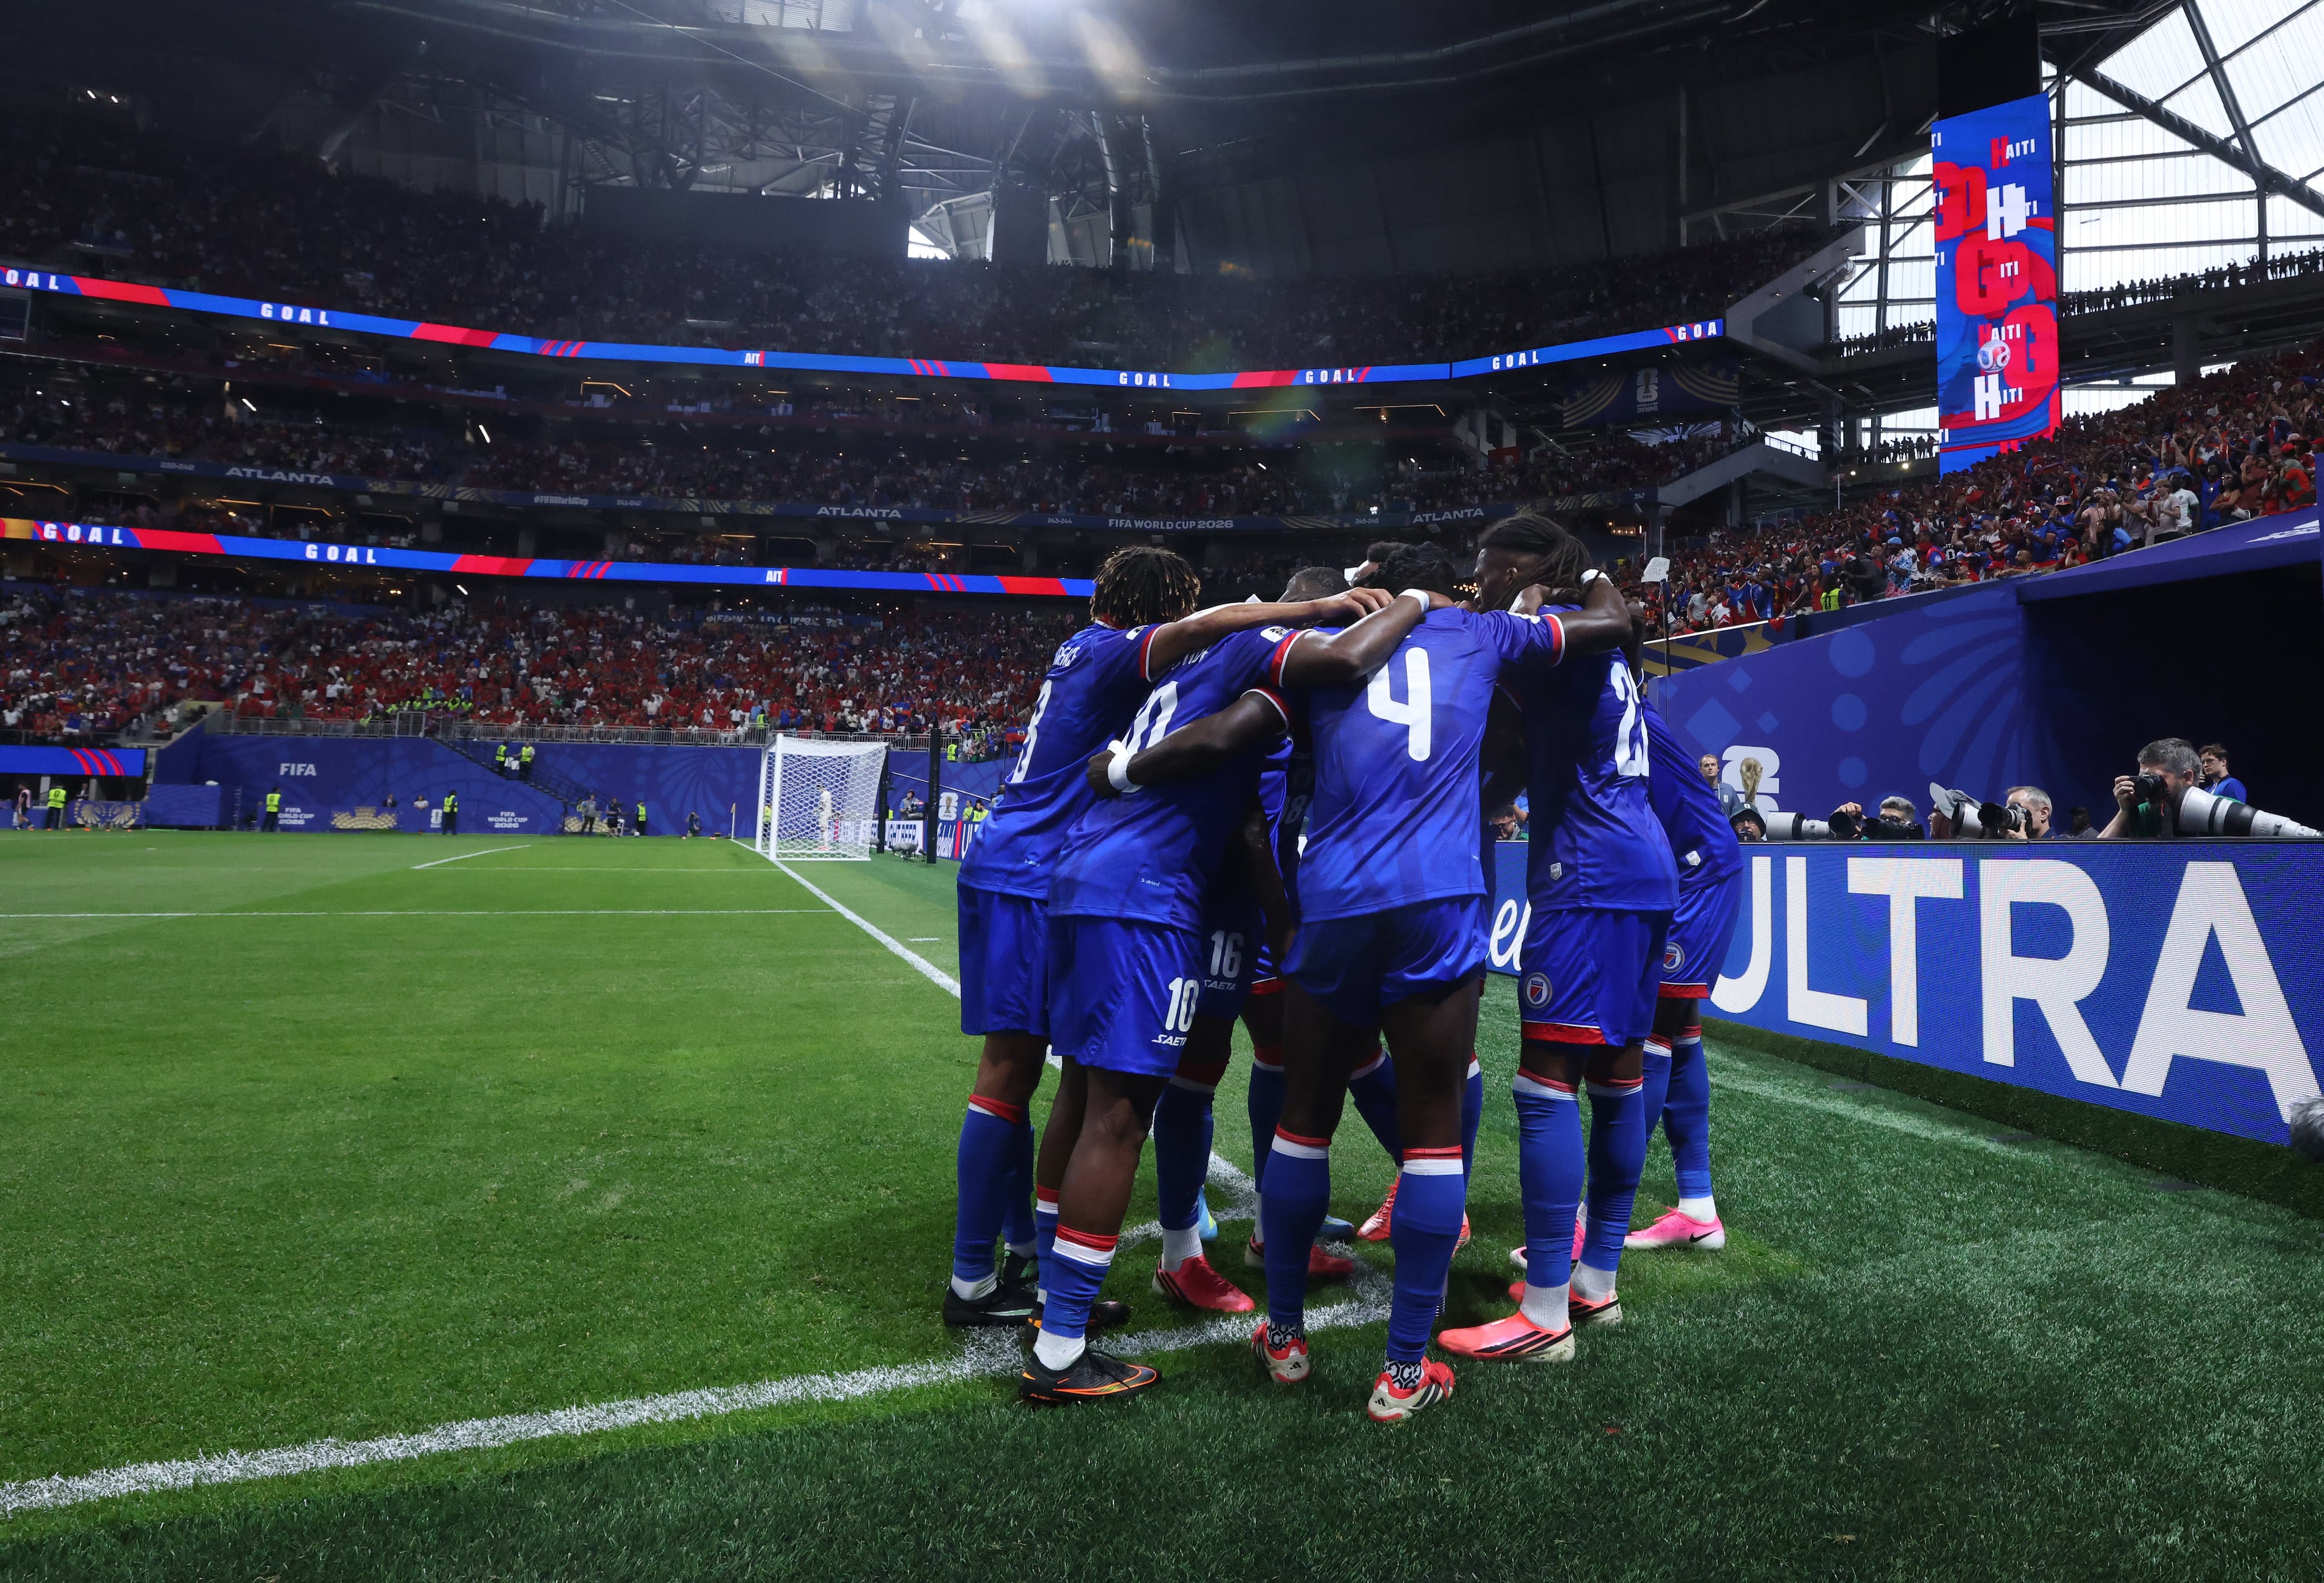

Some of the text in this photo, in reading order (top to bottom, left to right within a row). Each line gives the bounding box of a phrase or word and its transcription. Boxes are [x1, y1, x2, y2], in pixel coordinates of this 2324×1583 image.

[1991, 136, 2035, 169] HAITI
[260, 303, 329, 326] GOAL
[1491, 350, 1540, 370] GOAL
[1118, 372, 1170, 388] GOAL
[1305, 368, 1356, 384] GOAL
[1974, 373, 2023, 422] HAITI
[225, 465, 333, 486] ATLANTA
[816, 505, 902, 519] ATLANTA
[1412, 507, 1485, 523] ATLANTA
[44, 523, 123, 545] GOAL
[1108, 518, 1234, 529] FIFA WORLD CUP 2026
[305, 543, 376, 564] GOAL
[1367, 647, 1432, 761] 4
[280, 763, 317, 777] FIFA
[1141, 877, 1161, 887] S-dried
[1210, 929, 1244, 978] 16
[1710, 856, 2322, 1124] ULTRA
[1165, 977, 1199, 1032] 10
